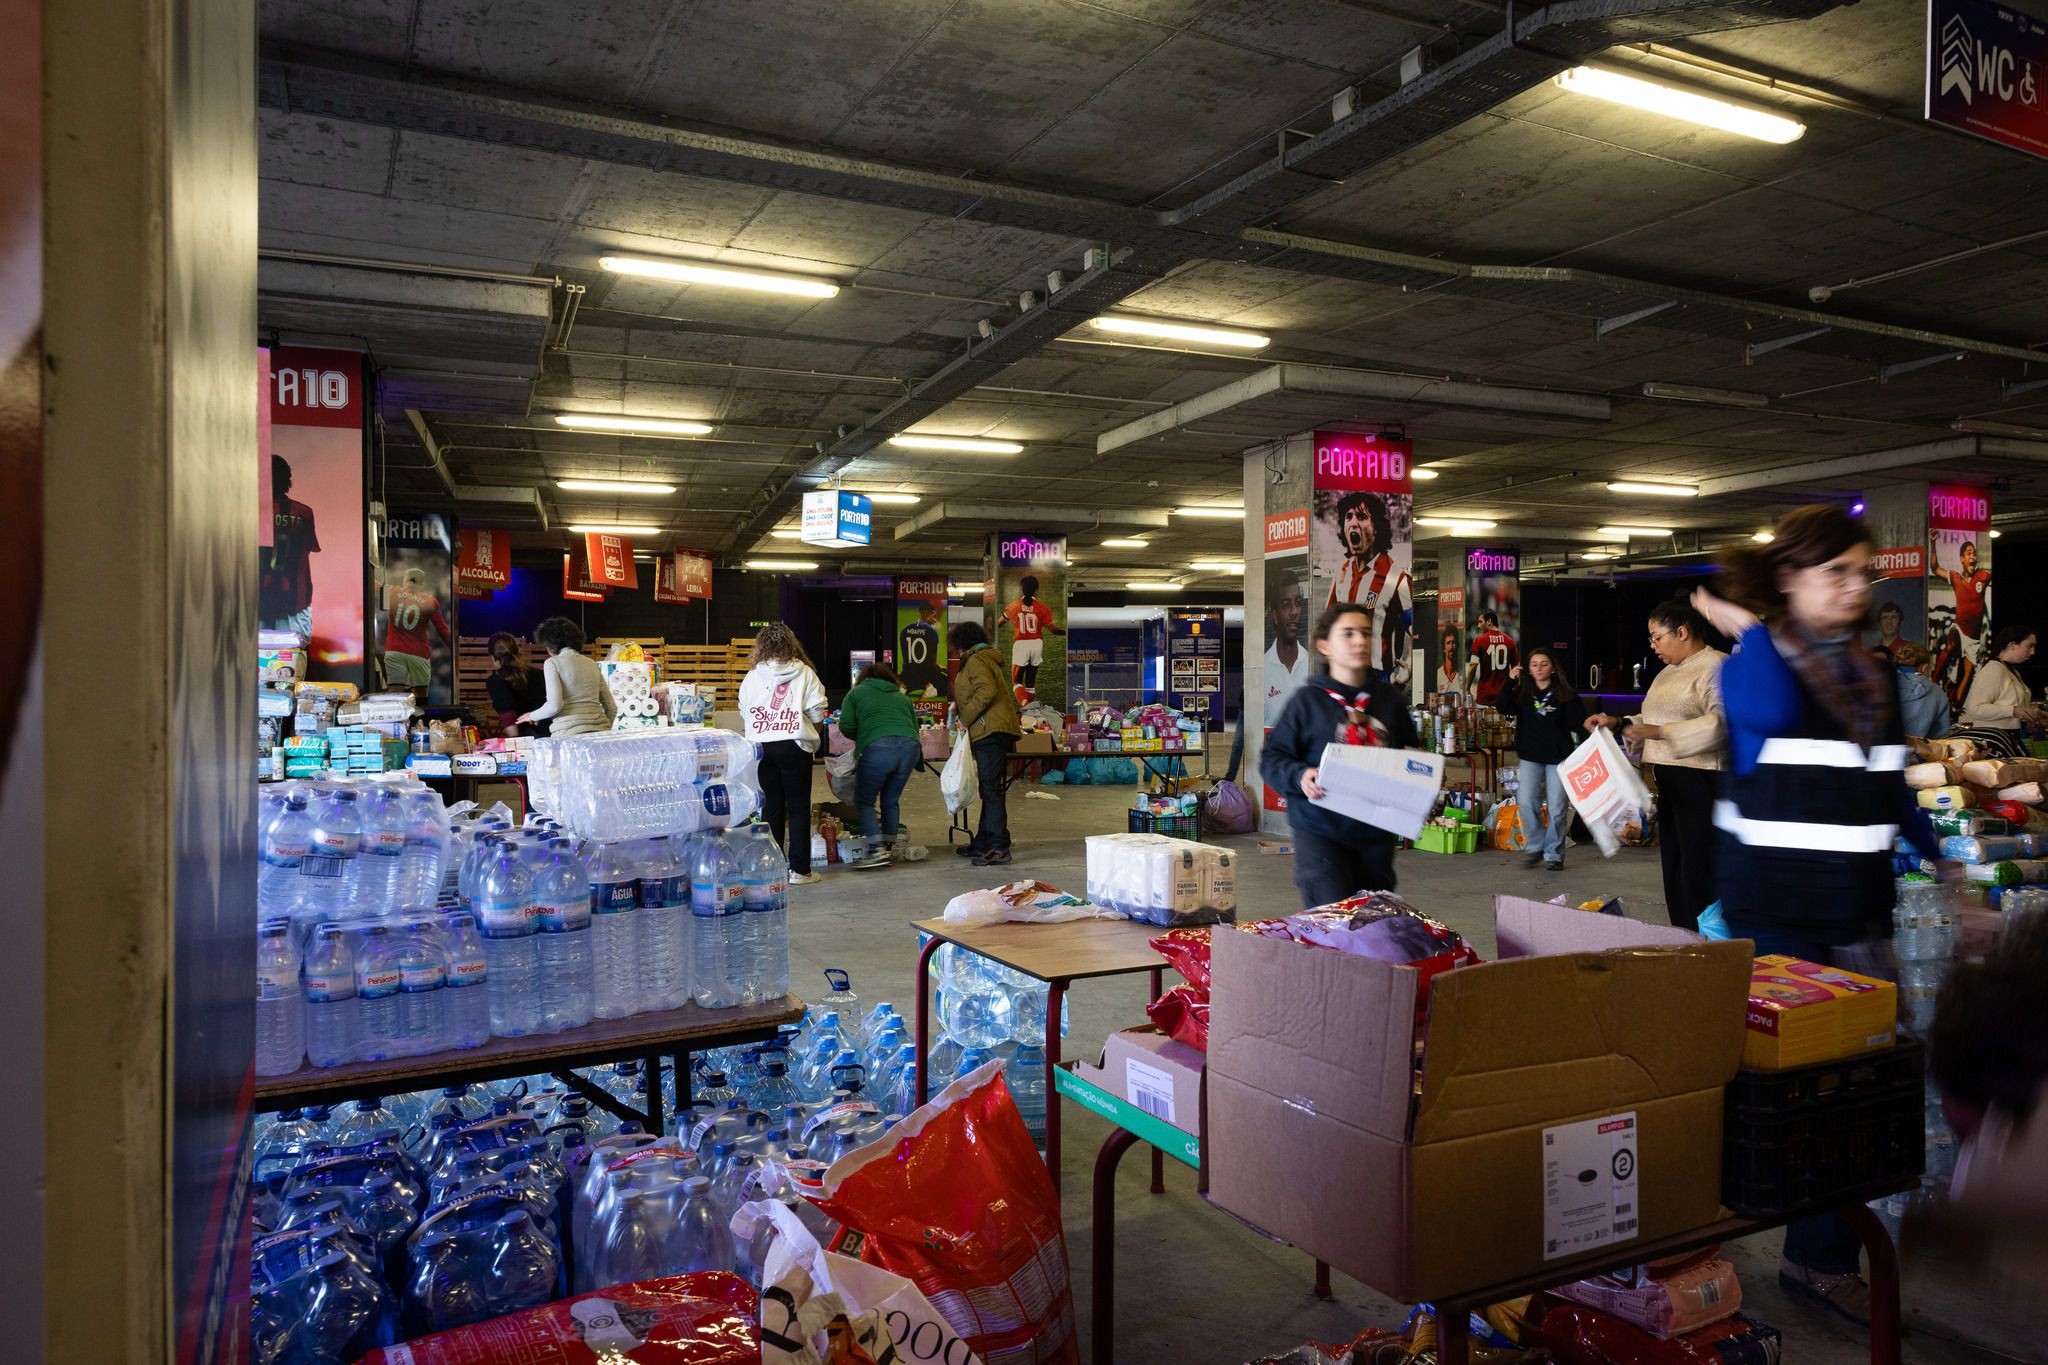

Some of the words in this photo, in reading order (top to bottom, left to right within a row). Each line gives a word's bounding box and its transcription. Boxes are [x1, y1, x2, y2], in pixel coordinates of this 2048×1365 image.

[1976, 39, 2014, 102] WC
[1318, 446, 1406, 481] PORTA10
[840, 508, 870, 526] PORTA10
[1931, 495, 1988, 522] PORTA10
[1268, 516, 1306, 541] PORTA10
[1001, 540, 1061, 560] PORTA10
[1467, 554, 1516, 572] PORTA10
[461, 567, 505, 583] ALCOBAÇA
[458, 586, 482, 597] OUREM
[686, 583, 703, 594] LEIRIA
[899, 581, 945, 594] PORTA10
[1440, 590, 1462, 603] PORTA10
[393, 602, 421, 631] 10
[1017, 612, 1039, 634] 10
[905, 636, 928, 664] 10
[1486, 644, 1508, 671] 10
[750, 706, 778, 722] Skip
[779, 707, 800, 723] the
[752, 720, 800, 734] Drama
[611, 886, 633, 901] ÁGUA
[1746, 1012, 1773, 1028] PACK
[1619, 1157, 1628, 1172] 2
